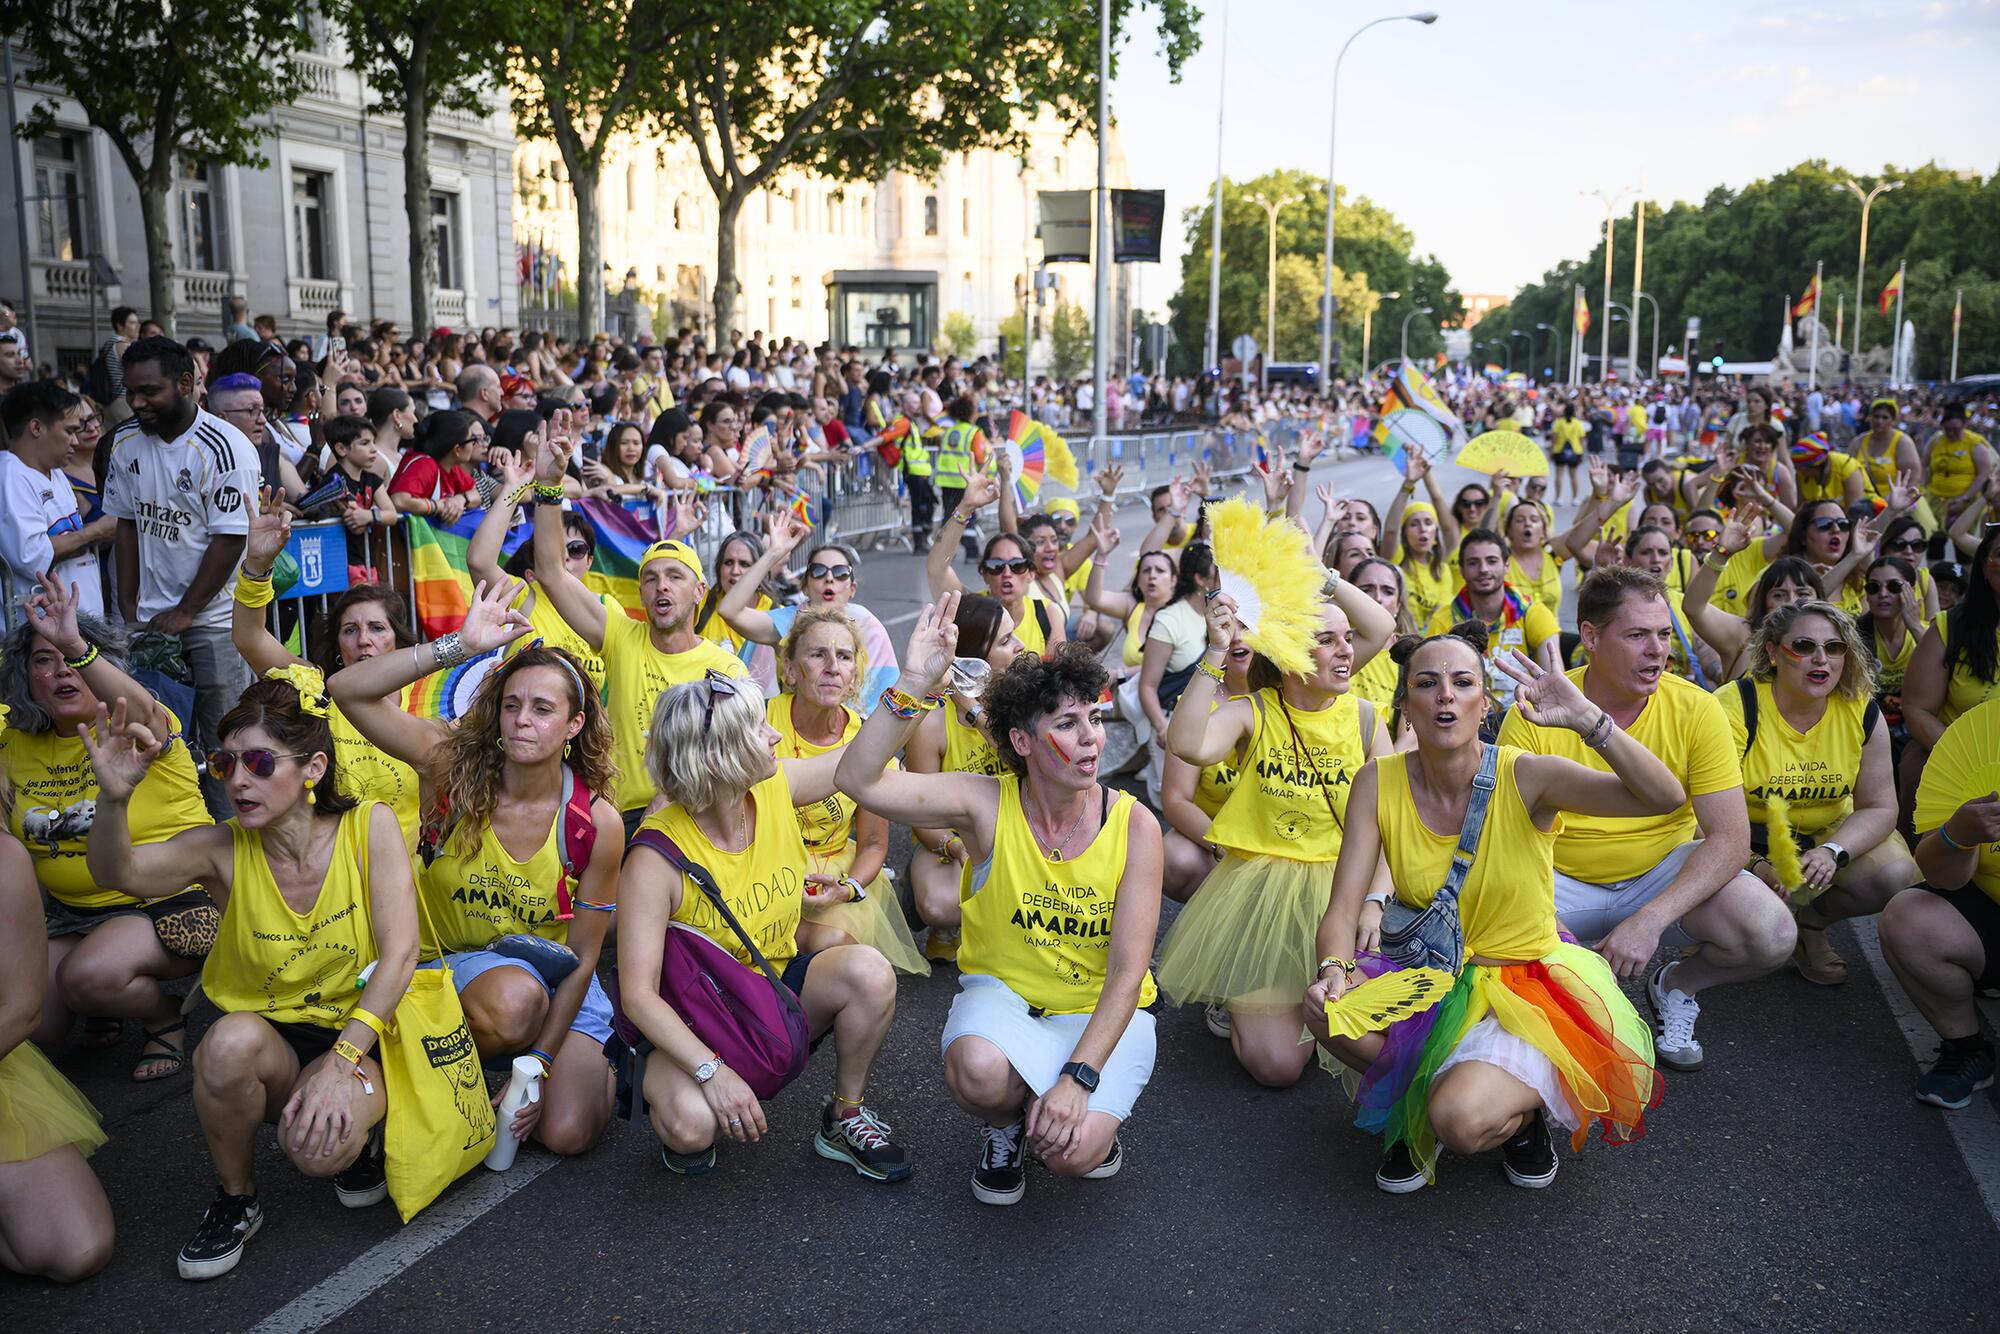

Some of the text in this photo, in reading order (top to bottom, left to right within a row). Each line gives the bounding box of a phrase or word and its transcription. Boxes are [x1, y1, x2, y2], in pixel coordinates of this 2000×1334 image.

[218, 490, 238, 513] hp
[150, 521, 179, 541] BETTER
[1317, 758, 1342, 768] SER
[1785, 761, 1828, 772] LA VIDA
[1256, 759, 1351, 788] AMARILLA
[1768, 773, 1843, 785] DEBERÍA SER
[1749, 784, 1851, 801] AMARILLA
[485, 862, 499, 875] LA
[1044, 879, 1098, 899] LA VIDA
[451, 887, 555, 925] AMARILLA
[520, 894, 547, 907] SER
[1022, 892, 1085, 916] DEBERÍA
[283, 933, 295, 942] LA
[296, 934, 309, 943] VO
[320, 917, 331, 928] LA
[1011, 907, 1112, 939] AMARILL
[325, 942, 357, 956] LABO
